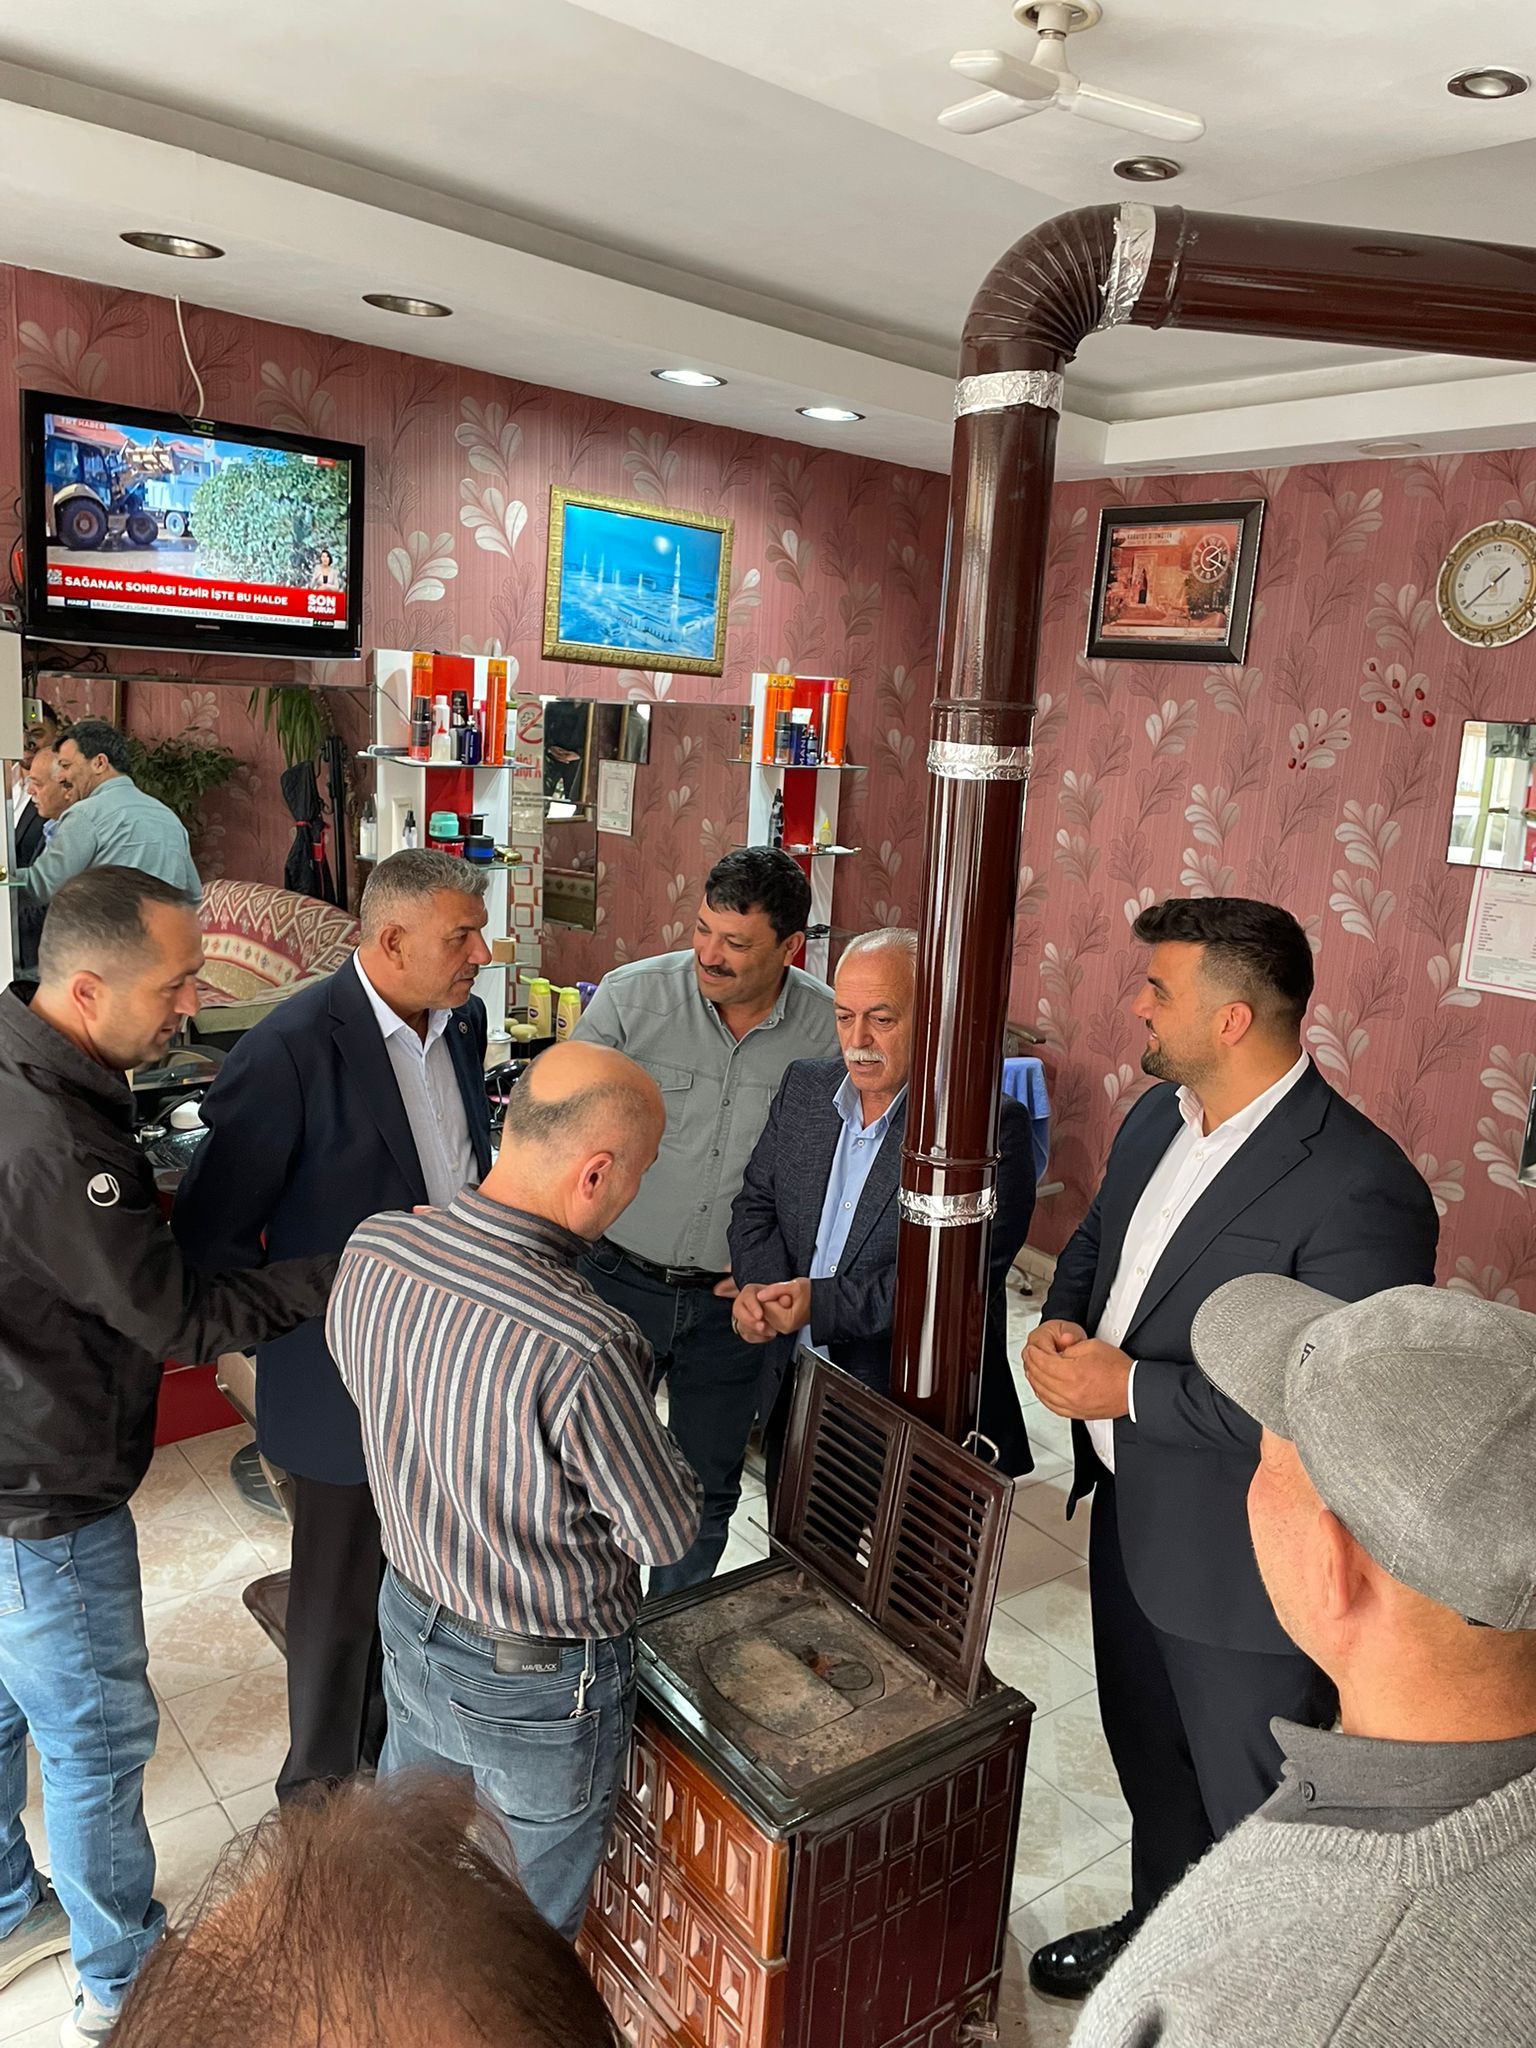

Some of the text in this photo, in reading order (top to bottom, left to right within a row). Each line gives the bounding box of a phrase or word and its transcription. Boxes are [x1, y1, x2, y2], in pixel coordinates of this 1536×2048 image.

[65, 576, 288, 606] SAĞANAK SONRASI İZMİR İŞTE BU HALDE
[307, 593, 336, 607] SON
